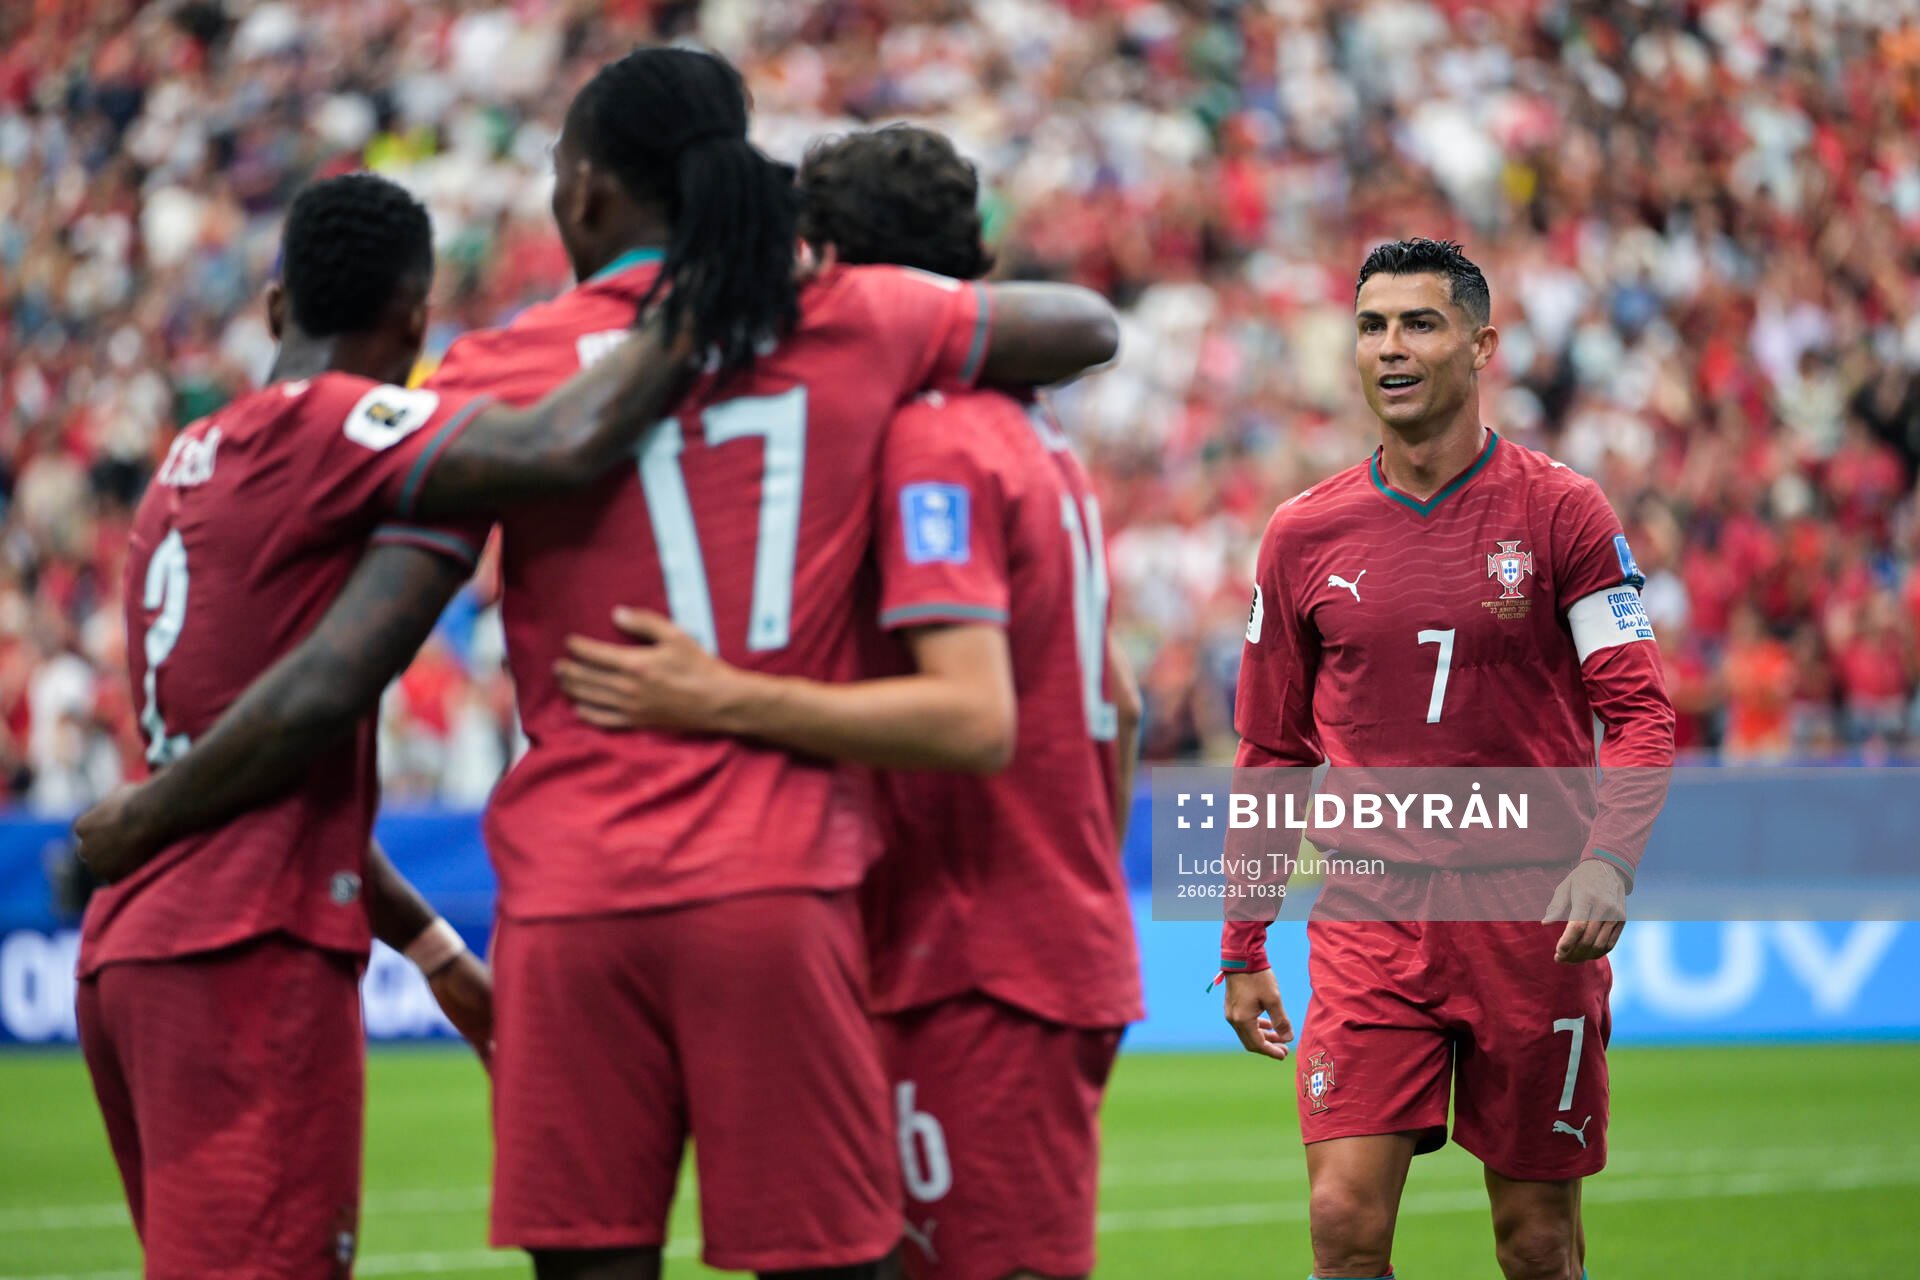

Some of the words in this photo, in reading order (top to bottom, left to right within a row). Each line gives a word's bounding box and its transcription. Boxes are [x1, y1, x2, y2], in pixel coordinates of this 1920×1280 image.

[637, 384, 807, 658] 17
[1616, 618, 1636, 631] the
[1417, 628, 1456, 724] 7
[1552, 1015, 1586, 1111] 7
[896, 1080, 953, 1203] 6
